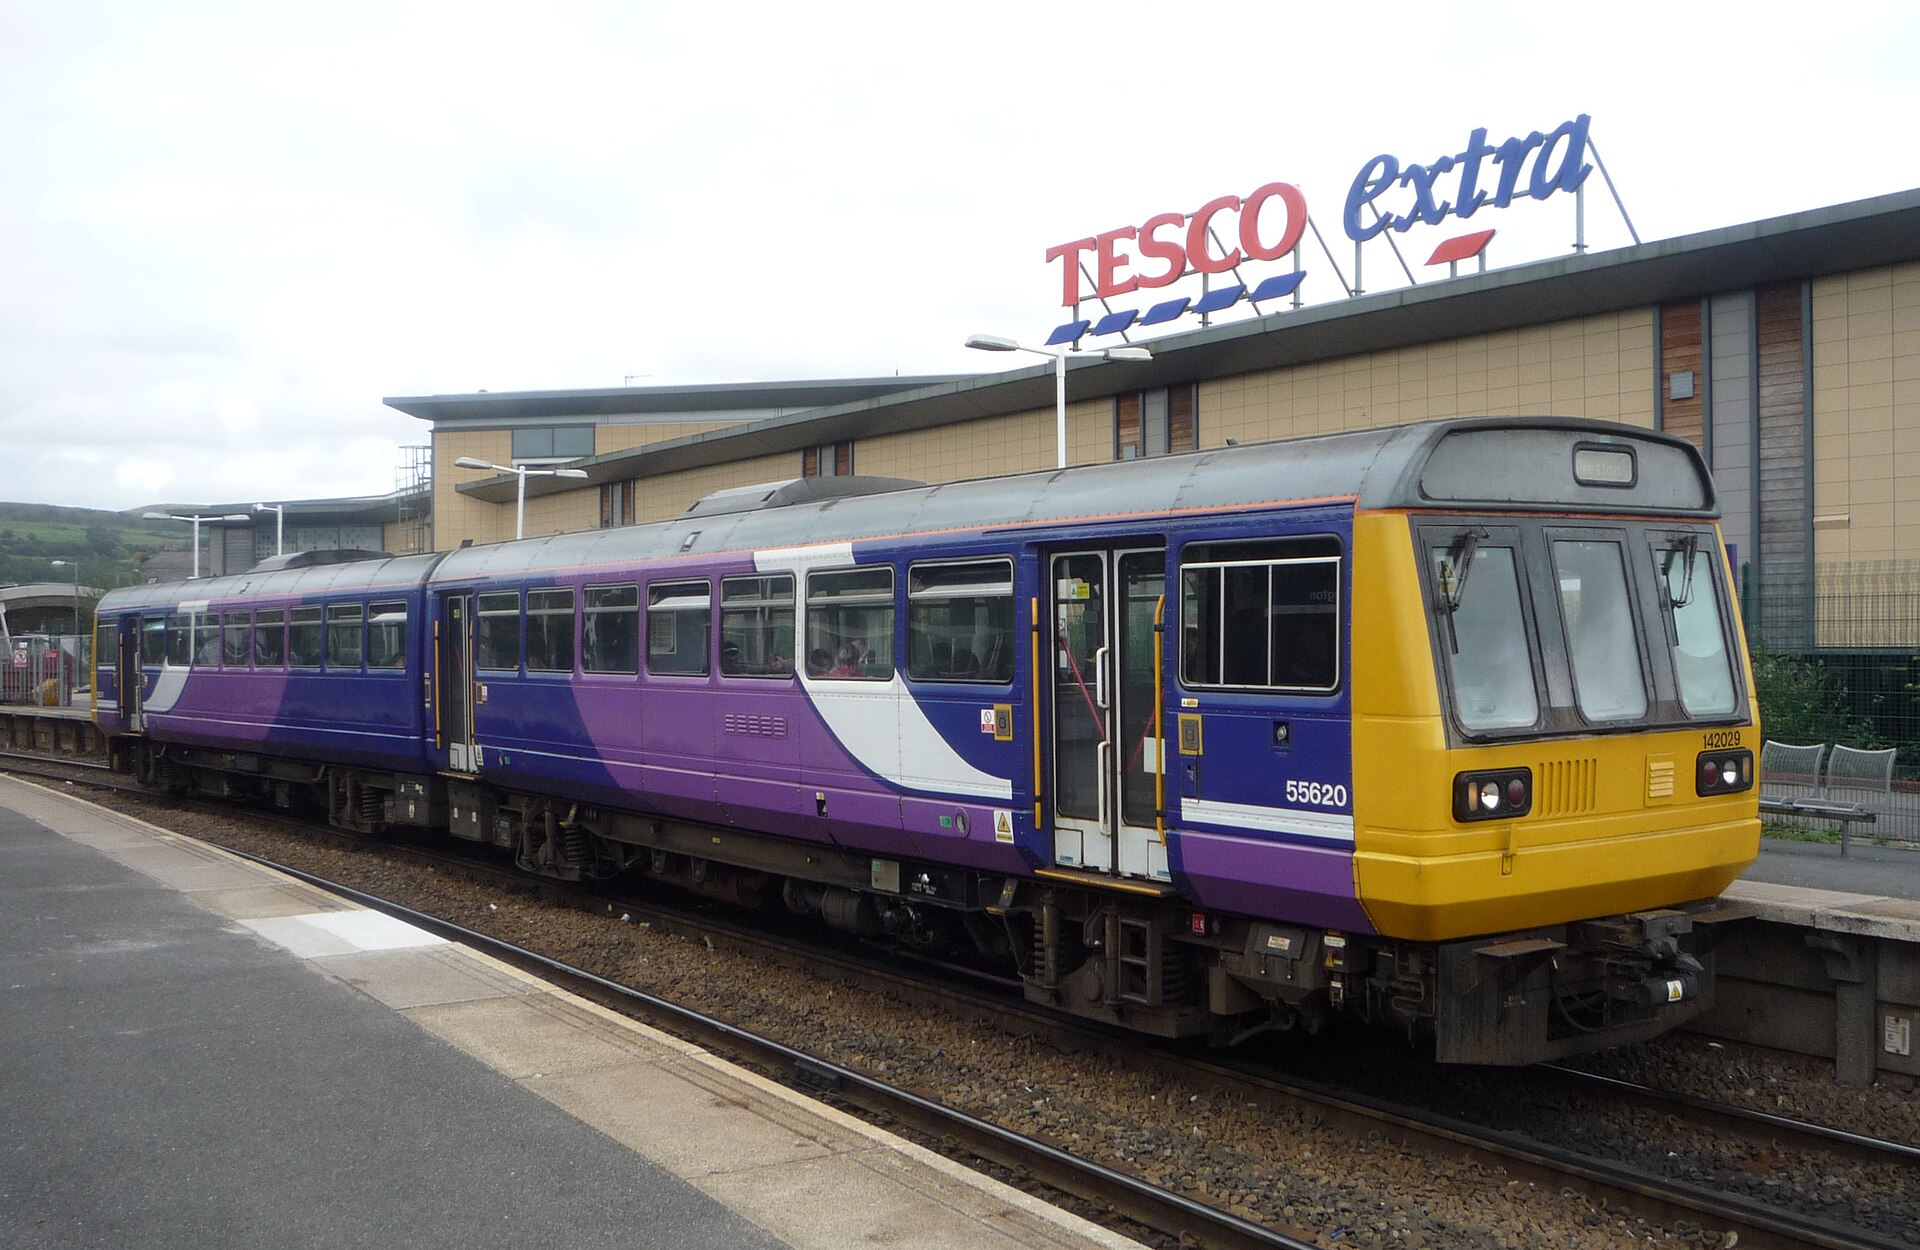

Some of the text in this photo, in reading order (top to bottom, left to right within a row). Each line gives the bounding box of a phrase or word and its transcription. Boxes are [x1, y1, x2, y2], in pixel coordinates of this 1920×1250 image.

[1045, 113, 1594, 307] TESCO extra
[1702, 730, 1741, 749] 142029
[1286, 780, 1347, 807] 55620
